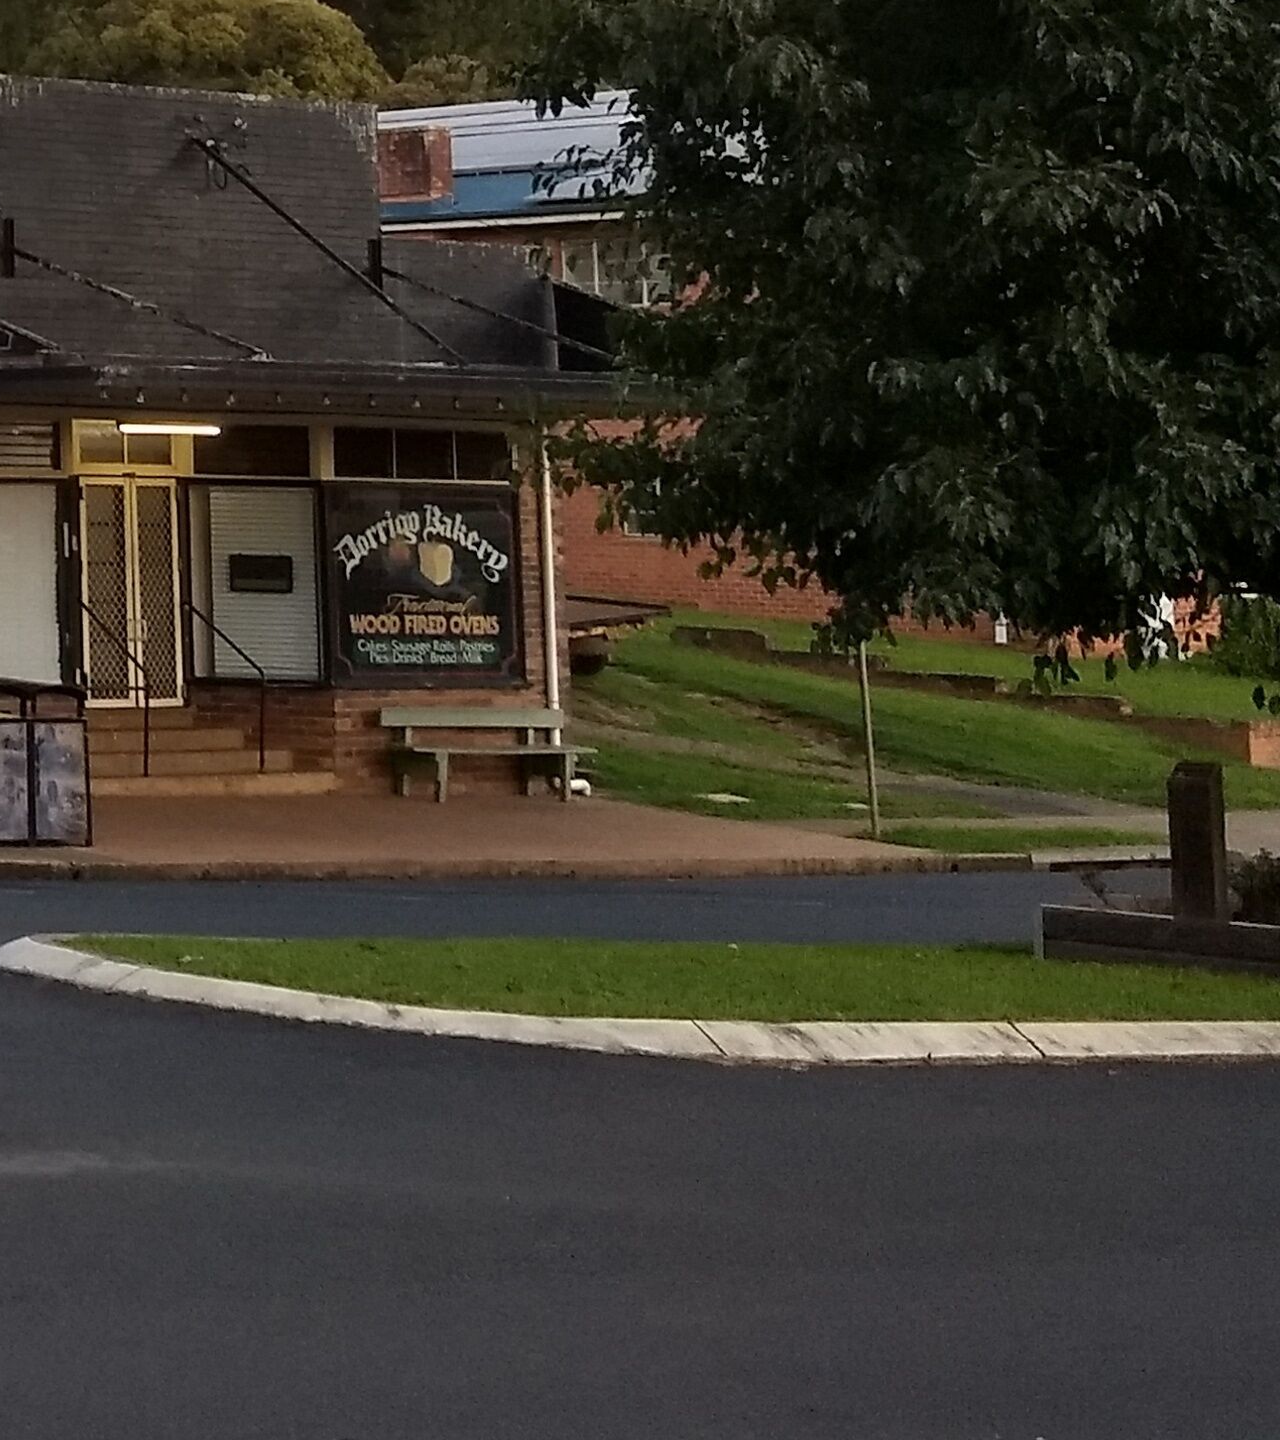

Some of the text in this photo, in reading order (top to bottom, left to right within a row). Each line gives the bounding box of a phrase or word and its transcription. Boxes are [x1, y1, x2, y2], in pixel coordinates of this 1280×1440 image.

[333, 504, 508, 583] Dorrigo Bakery
[349, 614, 500, 636] WOOD FIRED OVENS
[357, 639, 388, 652] Cakes
[433, 640, 455, 652] Rolls
[430, 652, 457, 664] Bread
